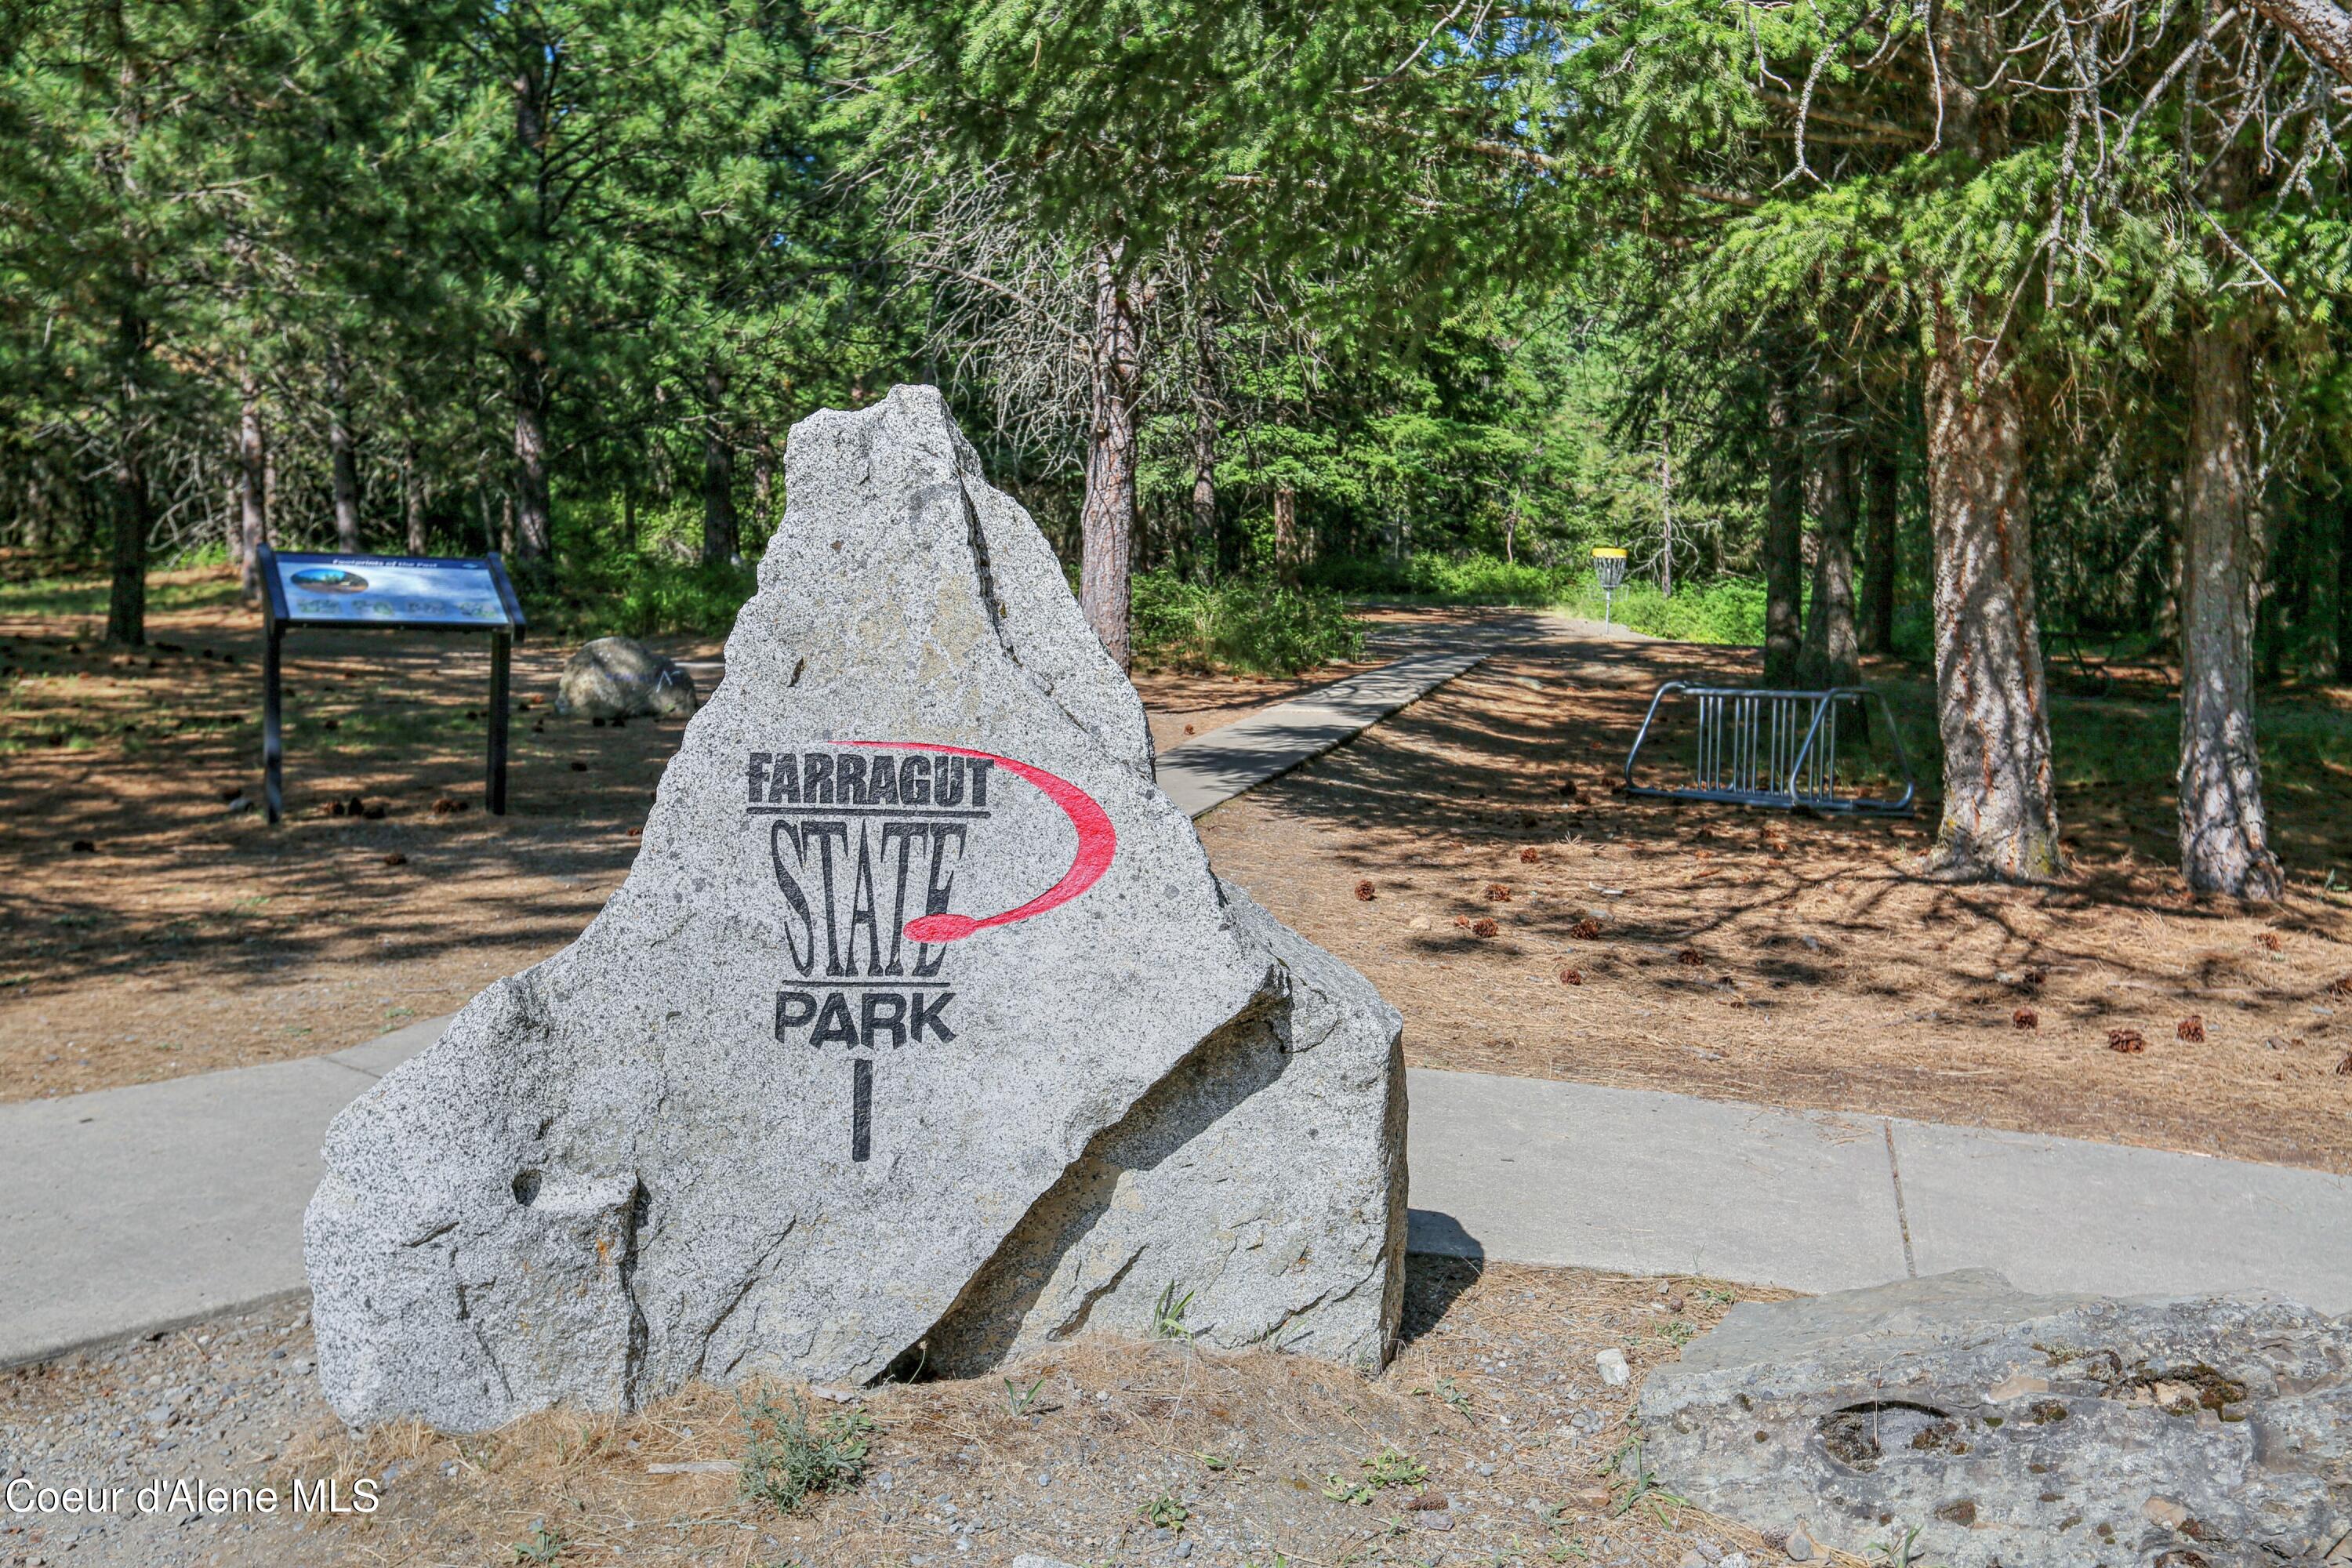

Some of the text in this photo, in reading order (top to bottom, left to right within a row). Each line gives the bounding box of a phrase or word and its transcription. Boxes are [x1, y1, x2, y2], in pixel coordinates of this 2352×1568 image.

[747, 752, 995, 808] FARRAGUT
[771, 818, 969, 978] STATE
[775, 991, 957, 1050] PARK
